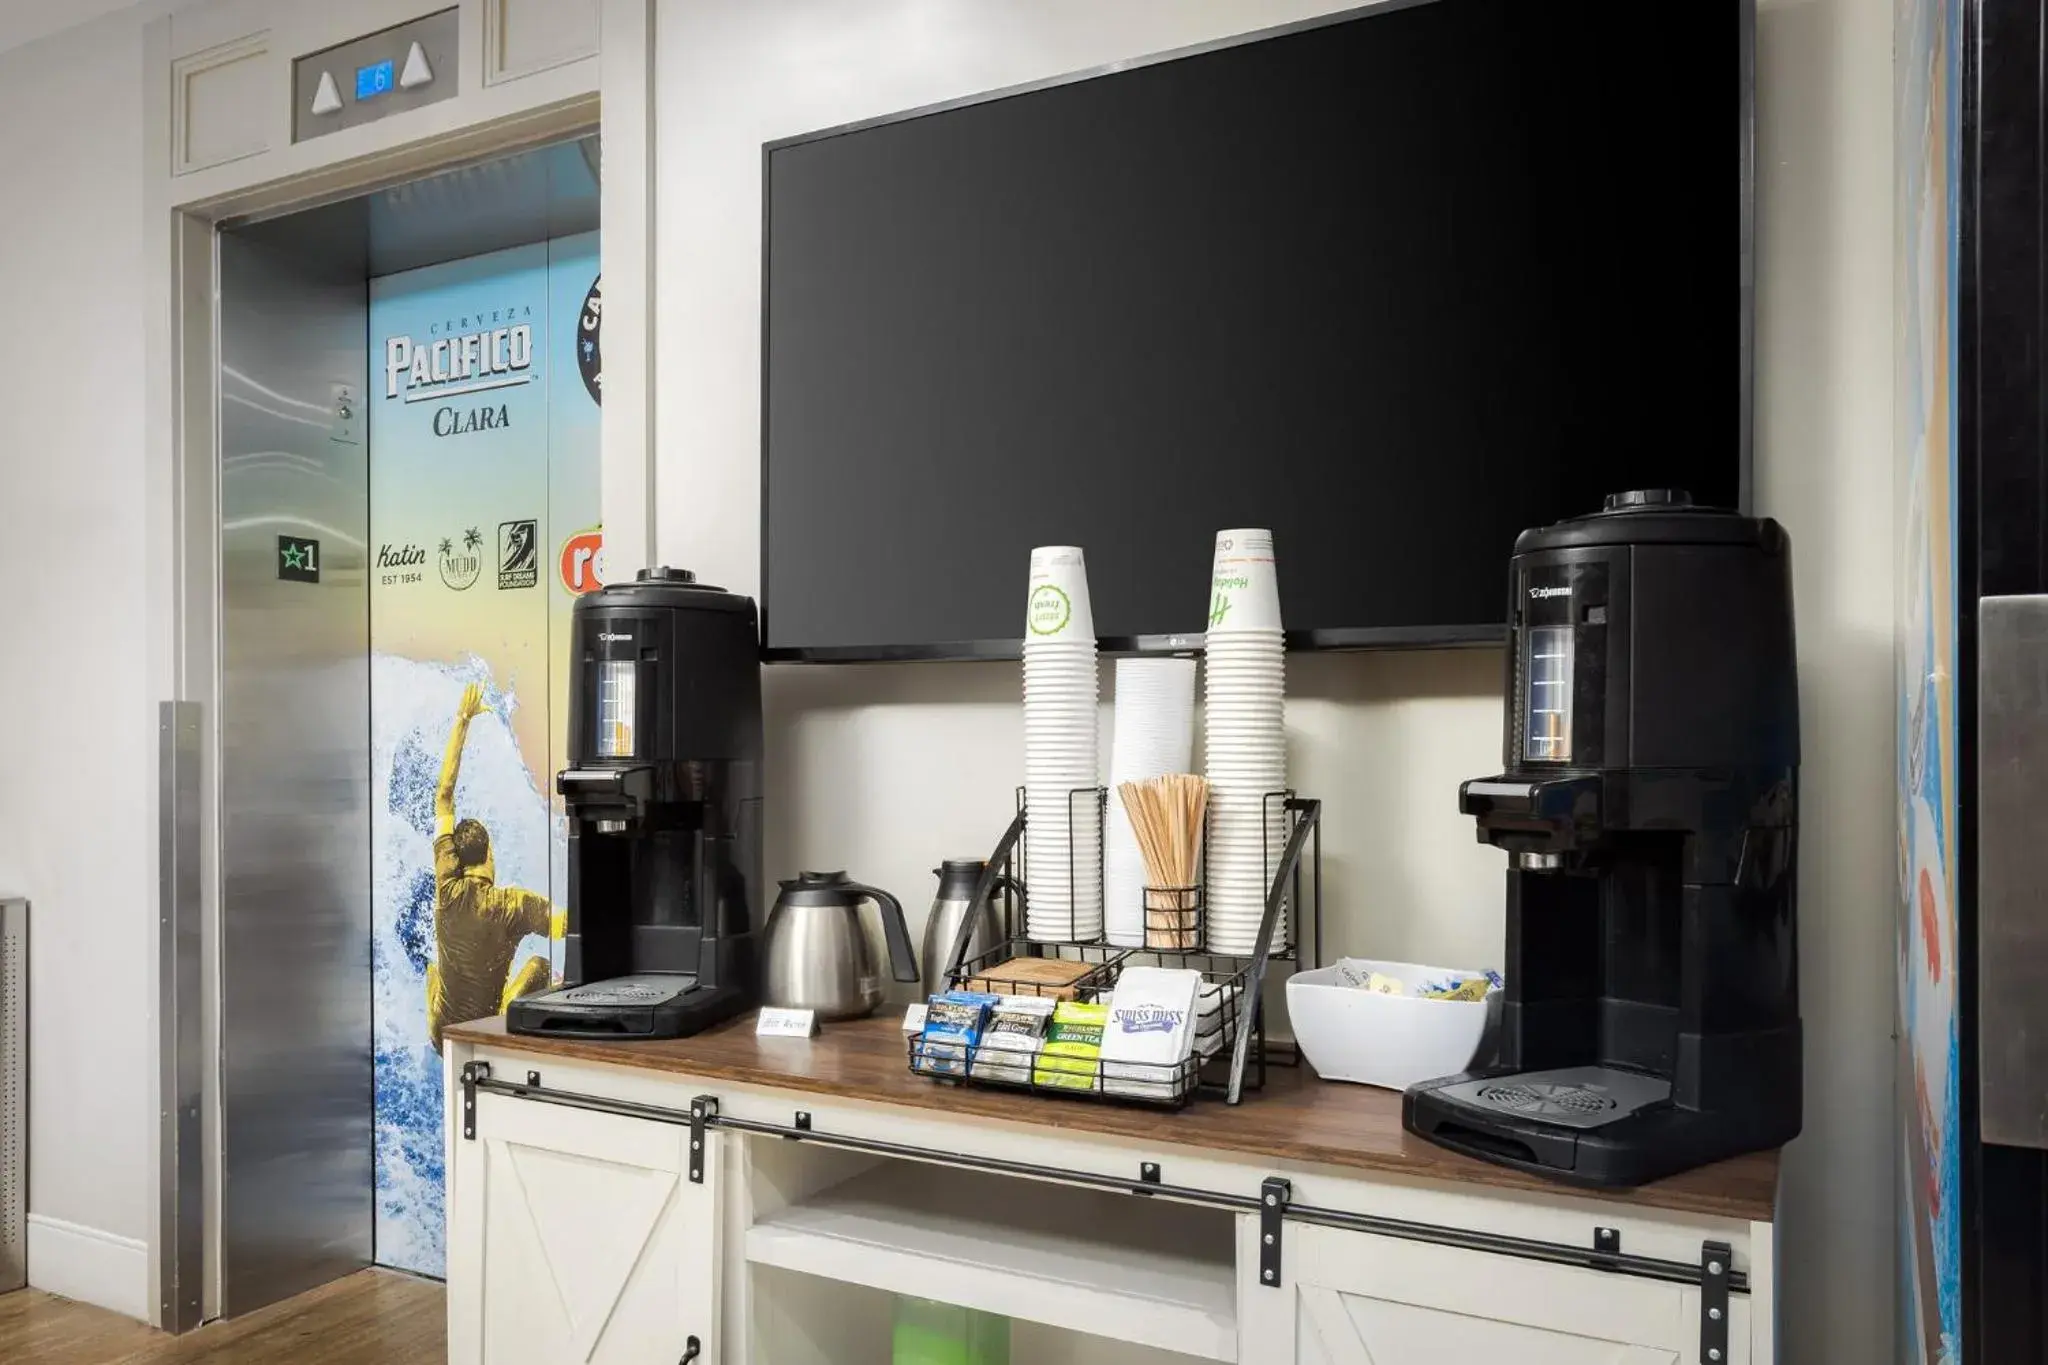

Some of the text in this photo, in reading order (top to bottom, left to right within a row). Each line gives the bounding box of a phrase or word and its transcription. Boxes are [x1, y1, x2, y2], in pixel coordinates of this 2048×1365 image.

[375, 66, 385, 91] 6
[430, 305, 533, 335] CERVEZA
[386, 323, 534, 400] PACIFICO
[433, 404, 510, 438] CLARA
[303, 544, 317, 572] 1
[376, 543, 426, 569] Katin
[382, 572, 422, 585] EST 1954
[1011, 1022, 1030, 1035] Grey
[1056, 1033, 1101, 1044] GREEN TEA
